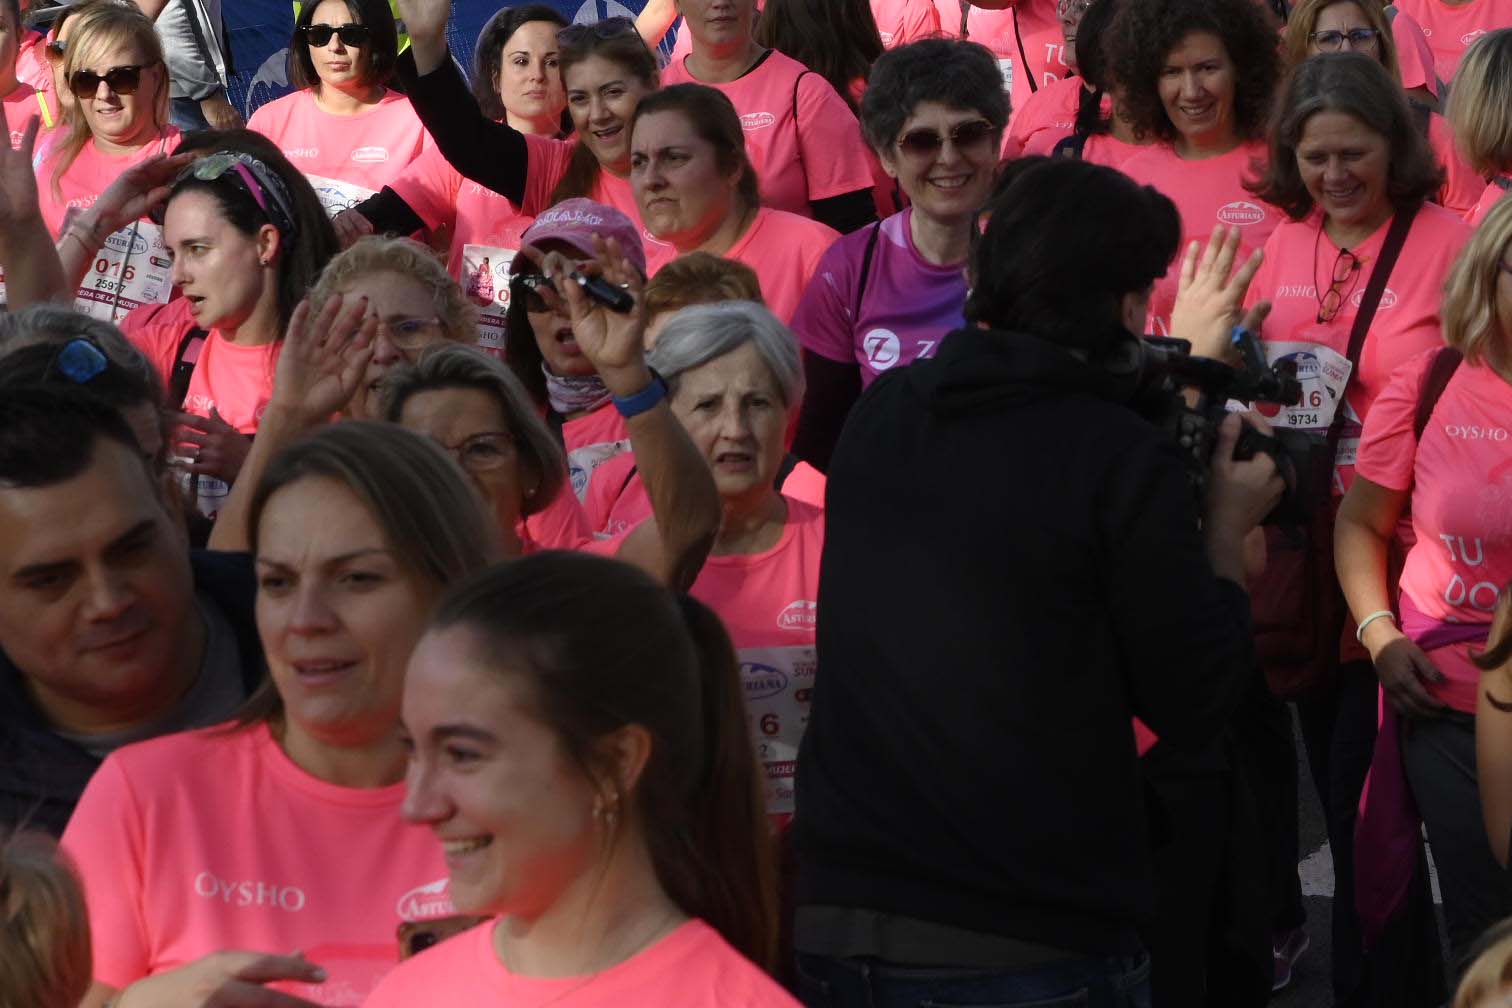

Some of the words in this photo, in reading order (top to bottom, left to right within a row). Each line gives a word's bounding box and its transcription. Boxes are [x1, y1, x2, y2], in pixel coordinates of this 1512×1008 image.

[95, 258, 136, 281] 016
[1445, 424, 1508, 441] OYSHO
[1440, 533, 1483, 566] TU
[194, 871, 306, 913] OYSHO
